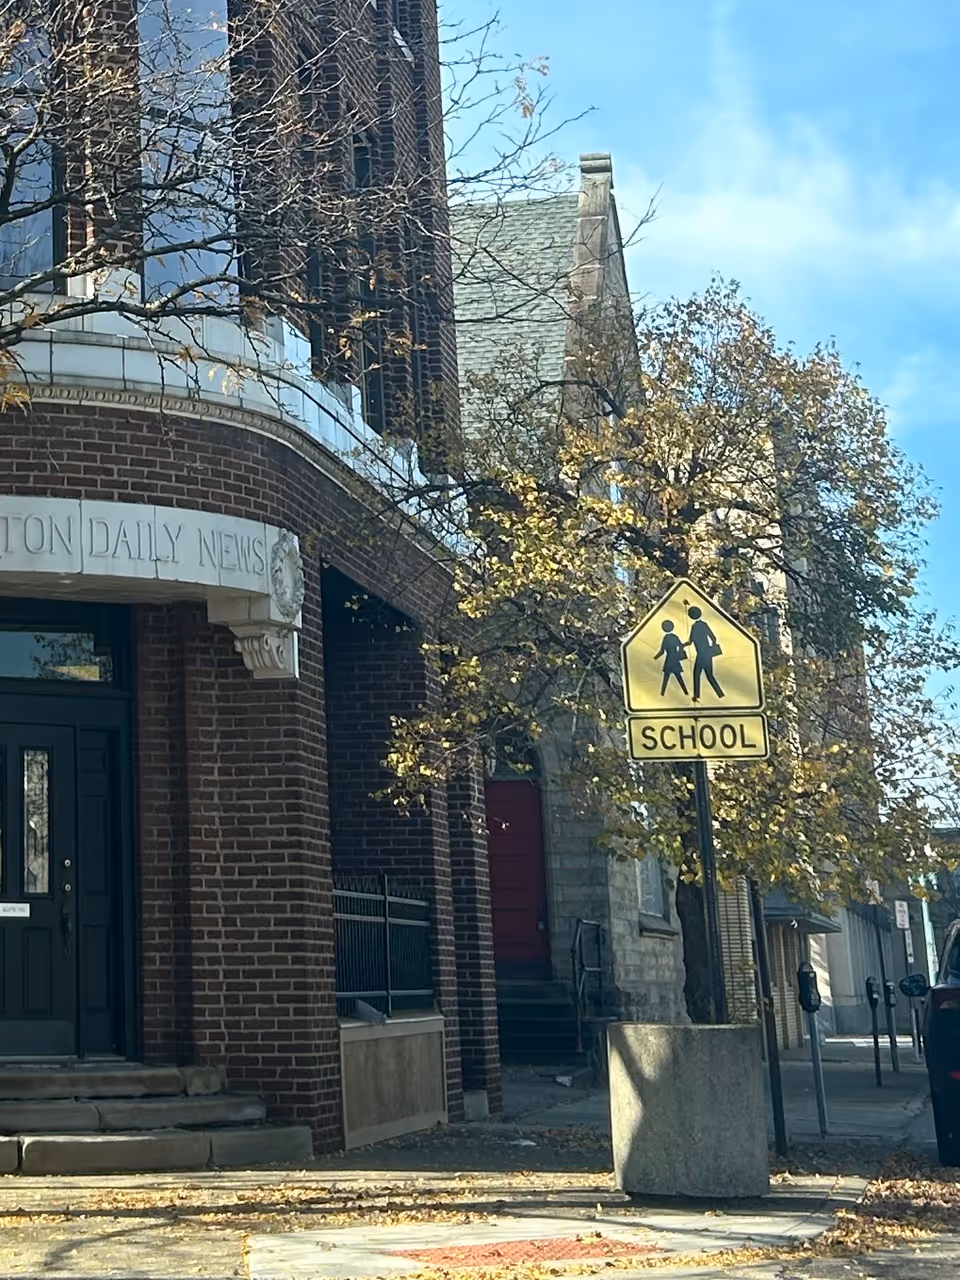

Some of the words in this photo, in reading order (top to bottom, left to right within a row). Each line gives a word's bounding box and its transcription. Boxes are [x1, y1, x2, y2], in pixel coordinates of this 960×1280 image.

[89, 518, 182, 563] DAILY
[197, 527, 265, 575] NEWS
[641, 724, 757, 750] SCHOOL
